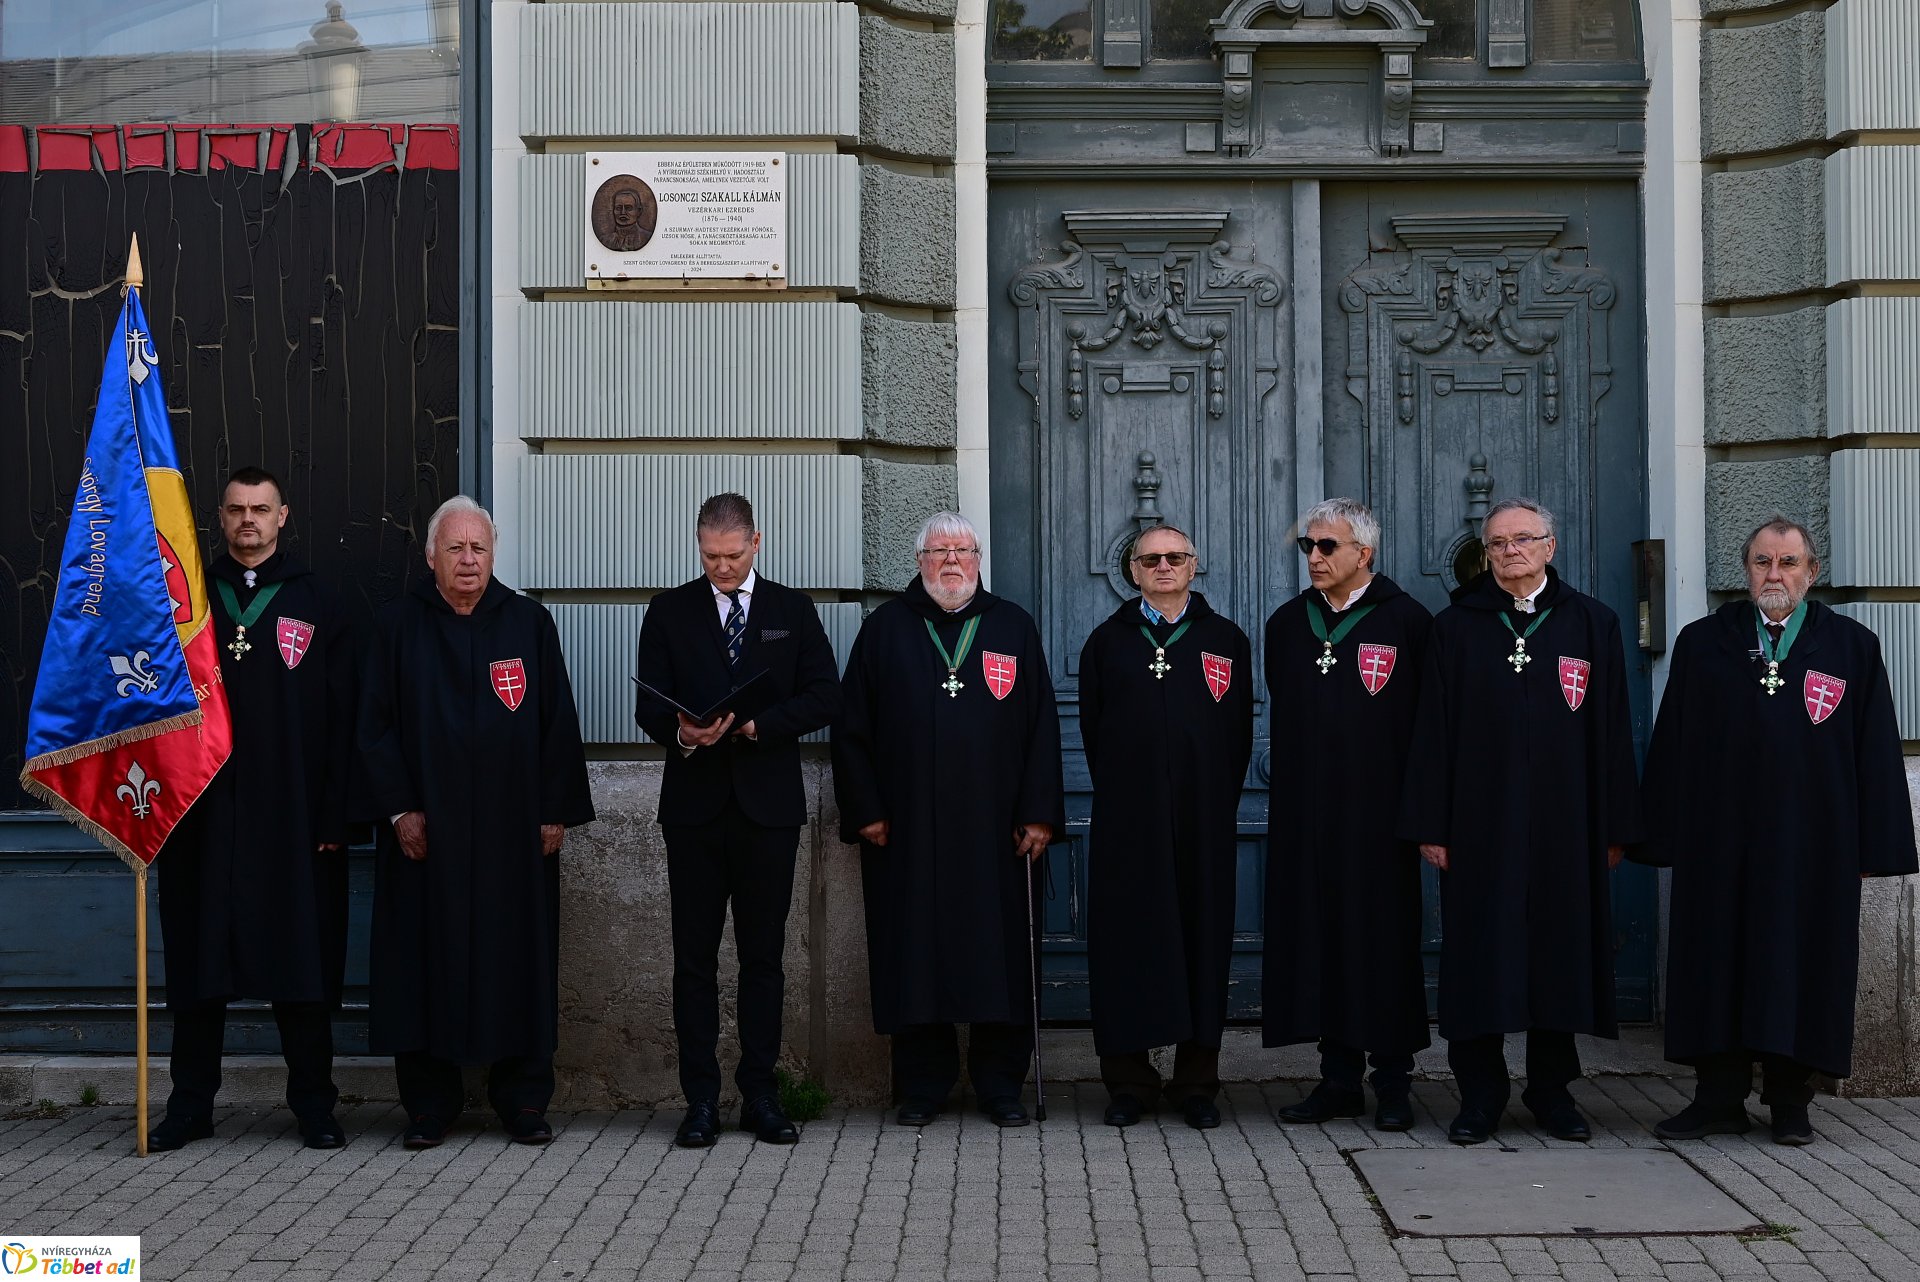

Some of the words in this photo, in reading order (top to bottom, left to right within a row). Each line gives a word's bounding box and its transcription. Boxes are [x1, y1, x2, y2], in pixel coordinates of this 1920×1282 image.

[659, 192, 698, 202] LOSONCZI
[702, 192, 741, 202] SZAKALL
[743, 190, 781, 202] KÁLMÁN
[81, 519, 111, 616] Lovagrend
